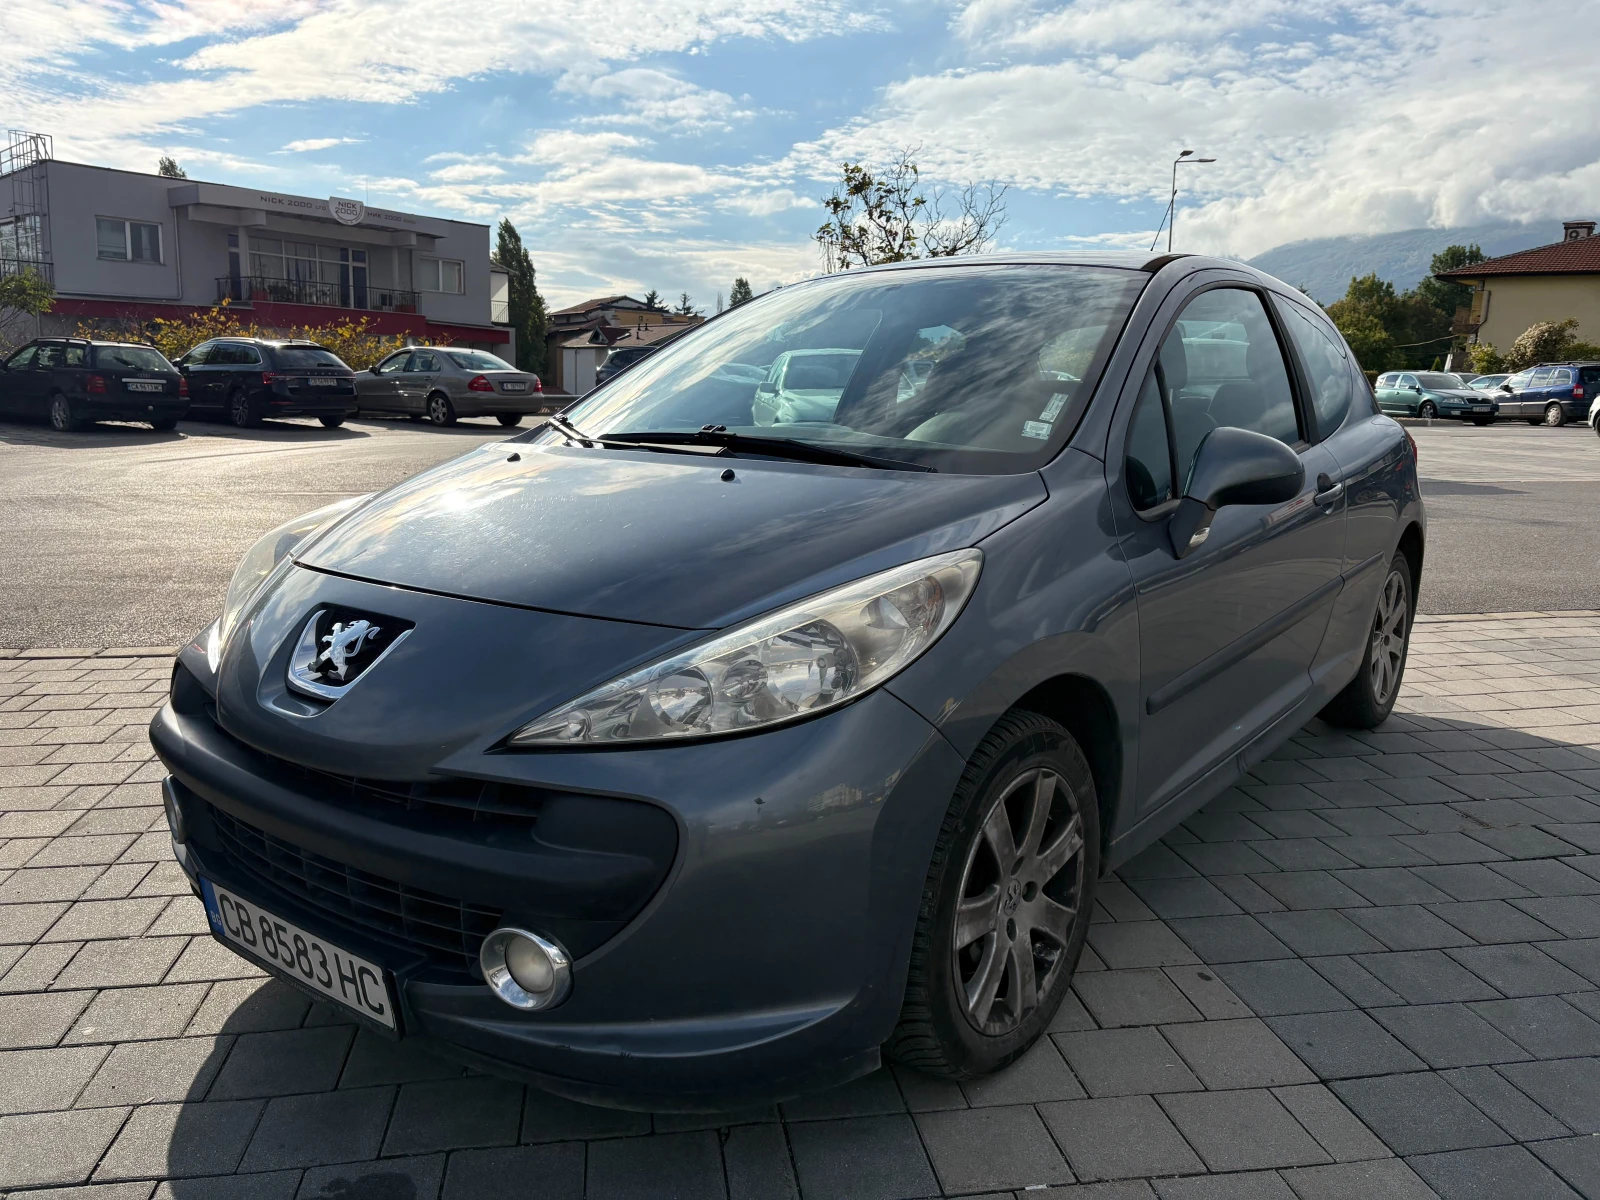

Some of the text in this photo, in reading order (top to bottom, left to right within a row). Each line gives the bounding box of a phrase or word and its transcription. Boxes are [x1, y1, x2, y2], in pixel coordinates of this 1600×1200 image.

[260, 196, 285, 205] NICK
[287, 200, 313, 209] 2000
[337, 201, 357, 210] NICK
[335, 207, 358, 216] 2000
[210, 910, 222, 926] BG
[219, 893, 258, 948] CB
[259, 915, 333, 989] 8583
[334, 952, 385, 1016] HC
